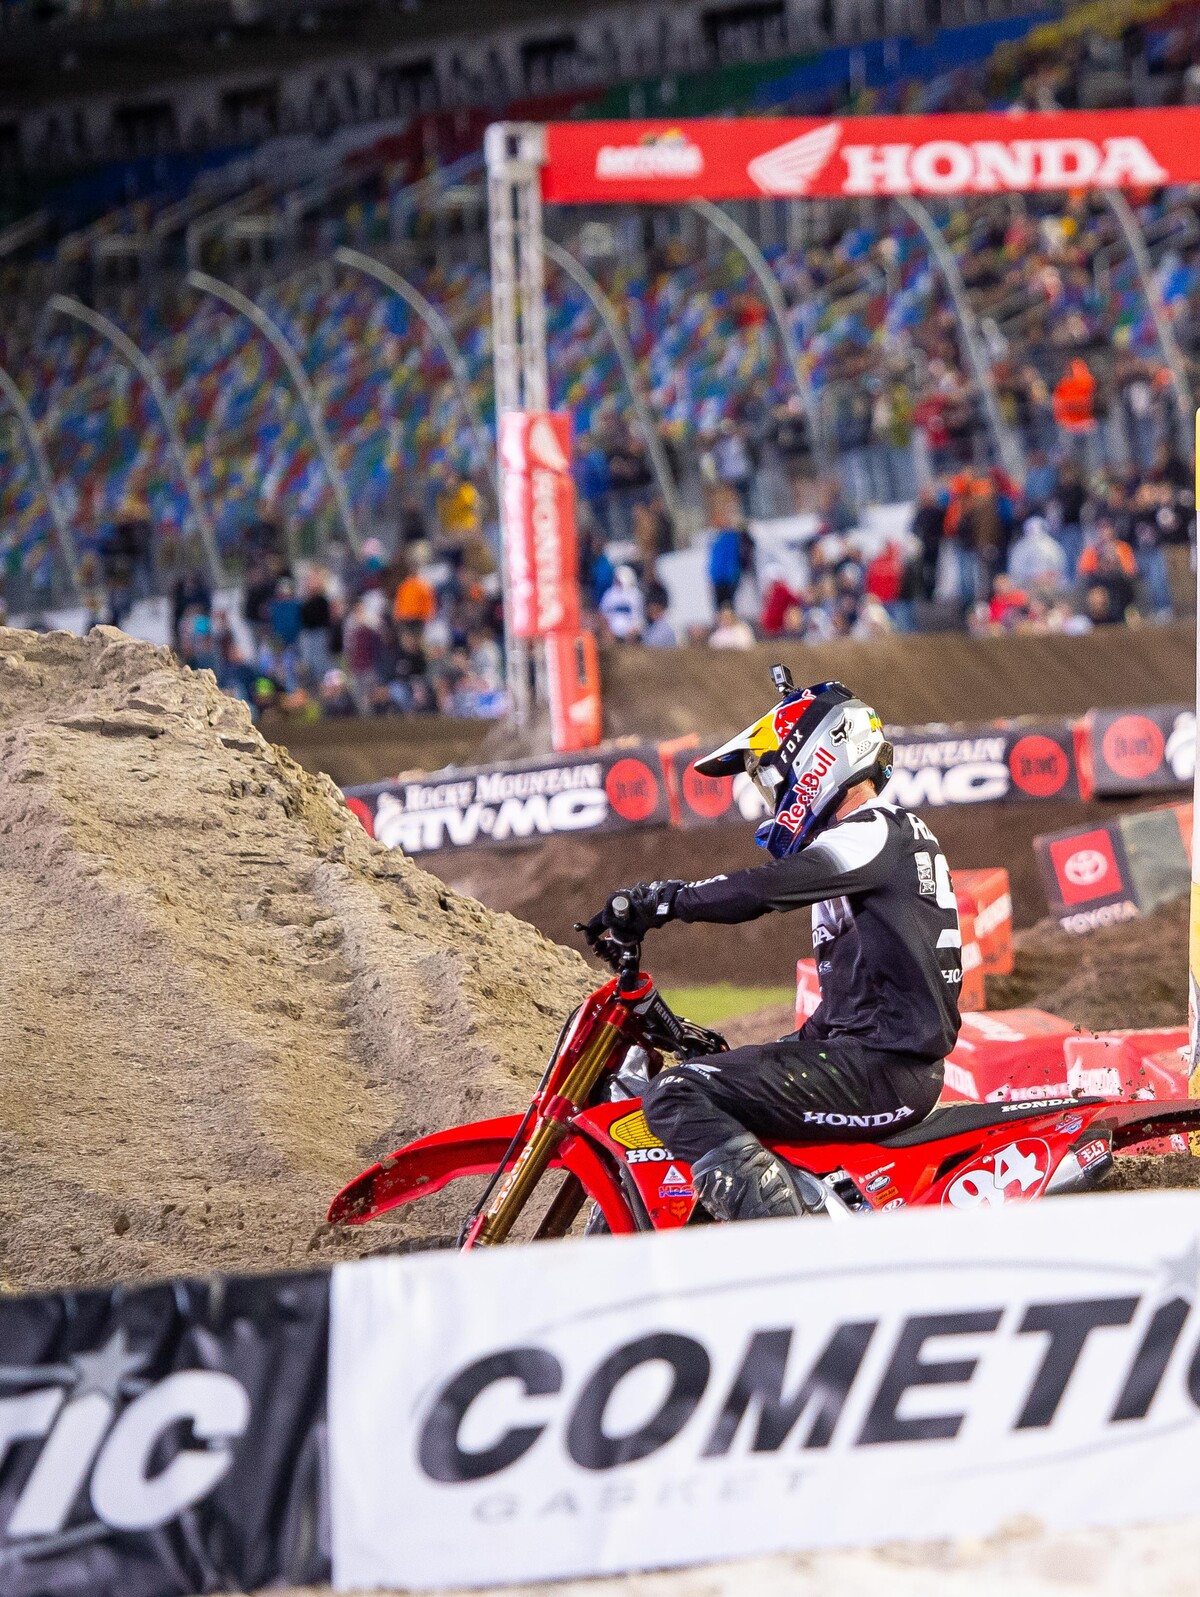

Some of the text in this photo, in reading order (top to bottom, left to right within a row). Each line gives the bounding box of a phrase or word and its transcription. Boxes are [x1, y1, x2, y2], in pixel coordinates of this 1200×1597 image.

[841, 136, 1168, 193] HONDA
[779, 728, 804, 765] FOX
[475, 762, 602, 799] MOUNTAIN
[1059, 899, 1140, 935] TOYOTA
[653, 1001, 682, 1041] RENTHAL
[803, 1105, 915, 1128] HONDA
[1001, 1098, 1079, 1113] HONDA
[949, 1143, 1045, 1209] 94
